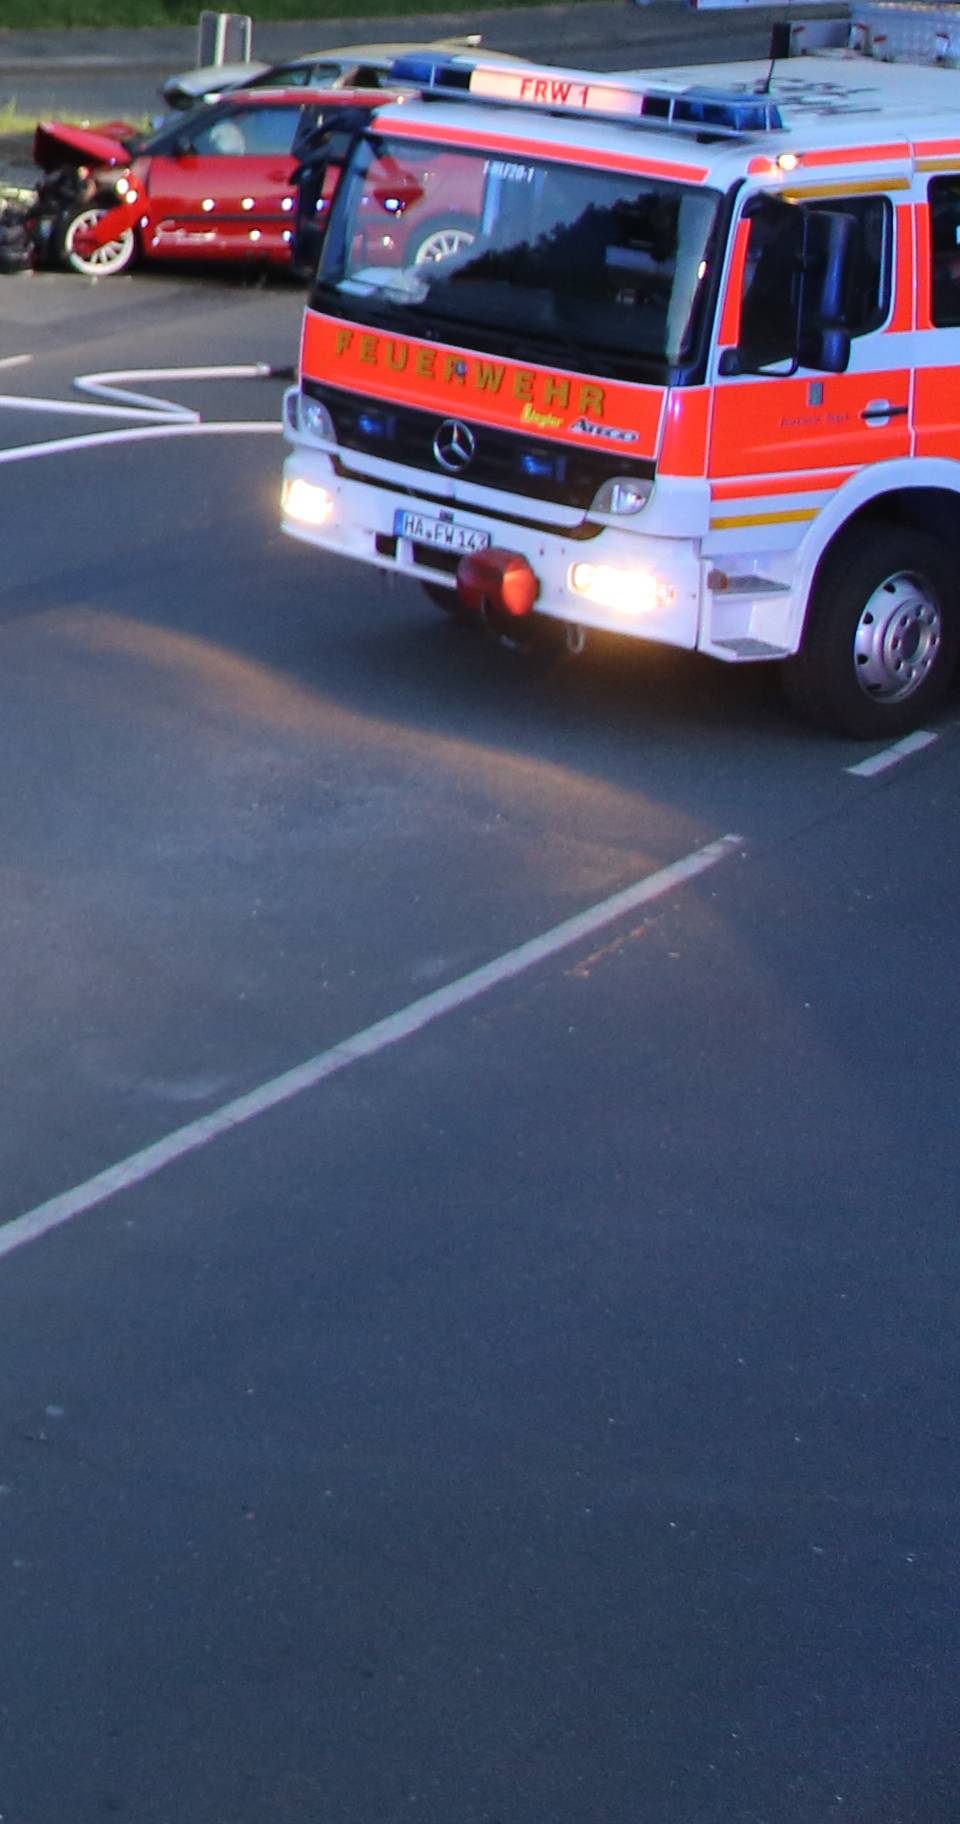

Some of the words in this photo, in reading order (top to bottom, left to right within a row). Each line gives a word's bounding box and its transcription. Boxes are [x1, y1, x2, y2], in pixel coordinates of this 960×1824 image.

[520, 78, 572, 104] FRW
[578, 86, 590, 108] 1
[336, 330, 606, 416] FEUERWEHR
